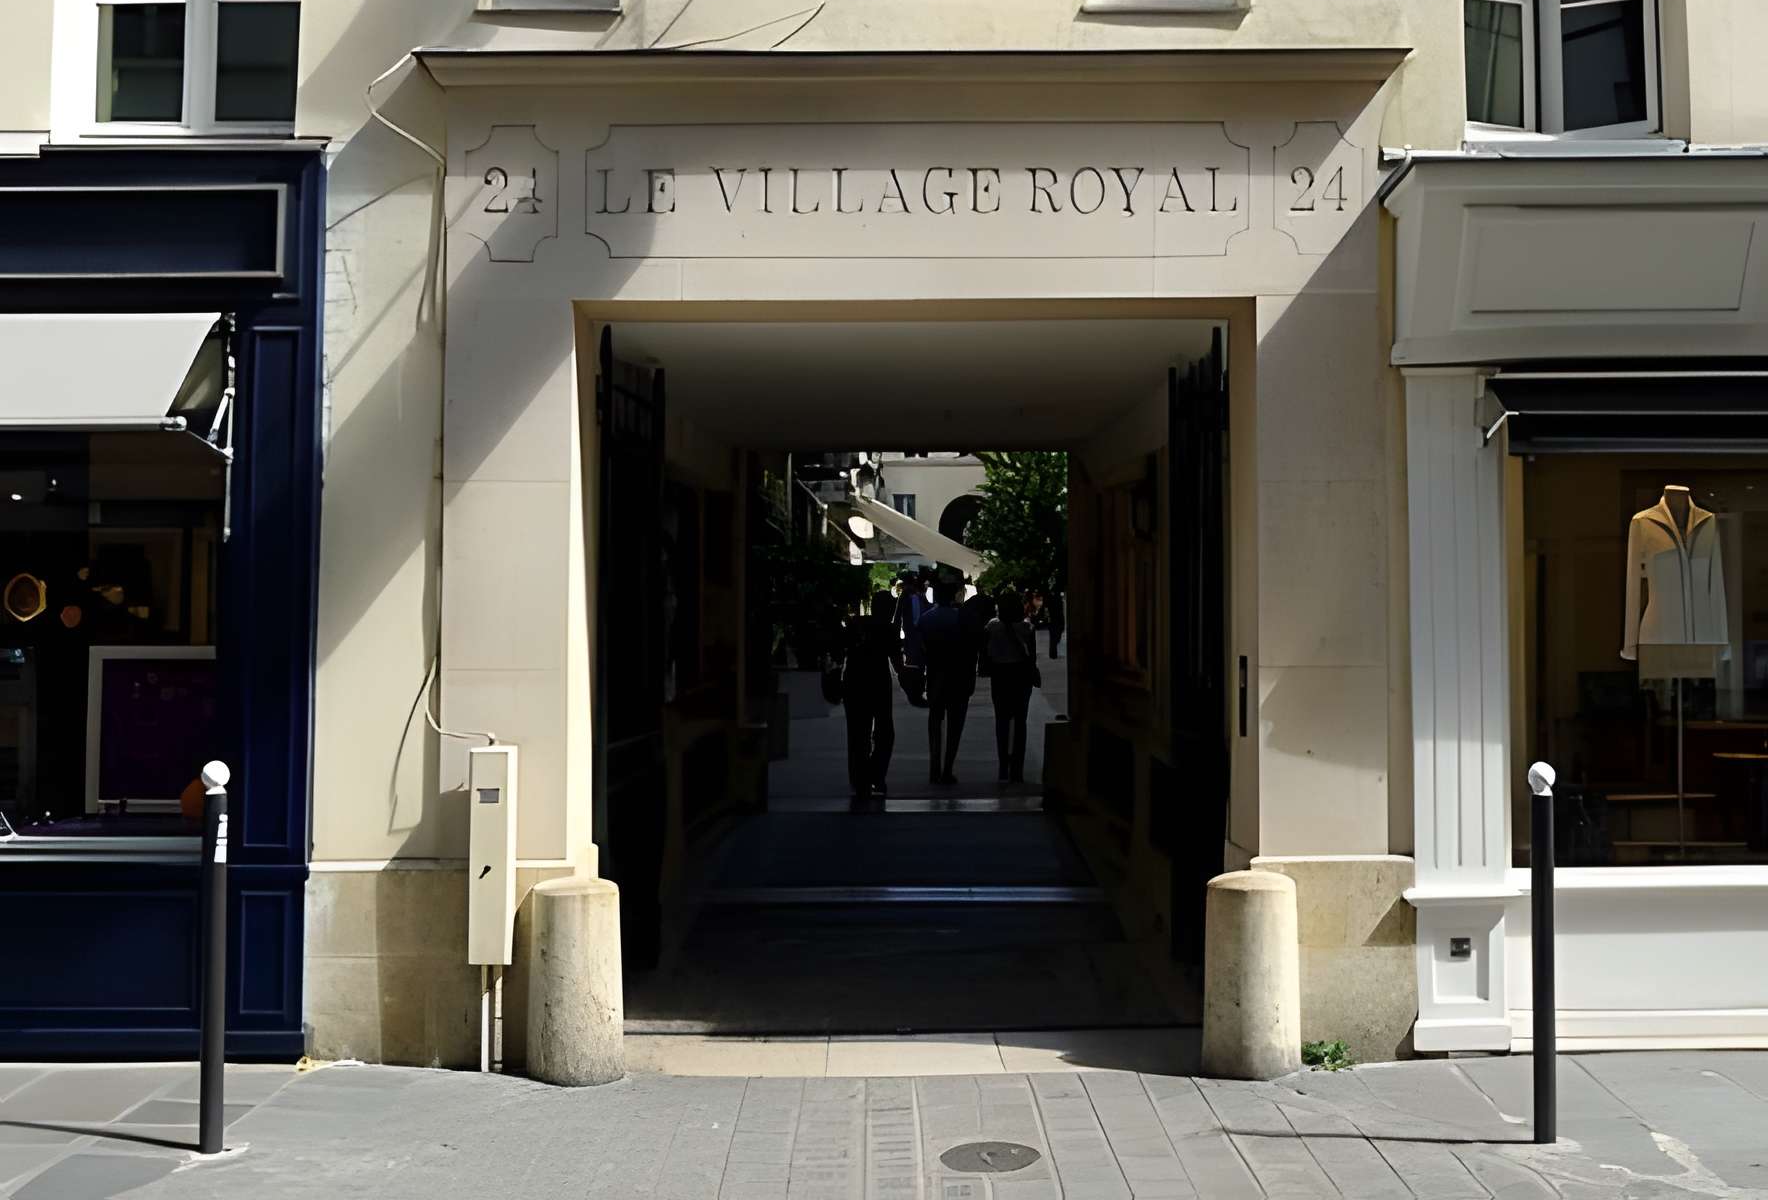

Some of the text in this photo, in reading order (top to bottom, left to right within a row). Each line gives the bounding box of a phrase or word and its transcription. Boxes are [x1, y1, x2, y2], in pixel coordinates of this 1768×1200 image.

[483, 166, 543, 214] 24
[595, 166, 1238, 216] LE VILLAGE ROYAL
[1290, 166, 1348, 212] 24
